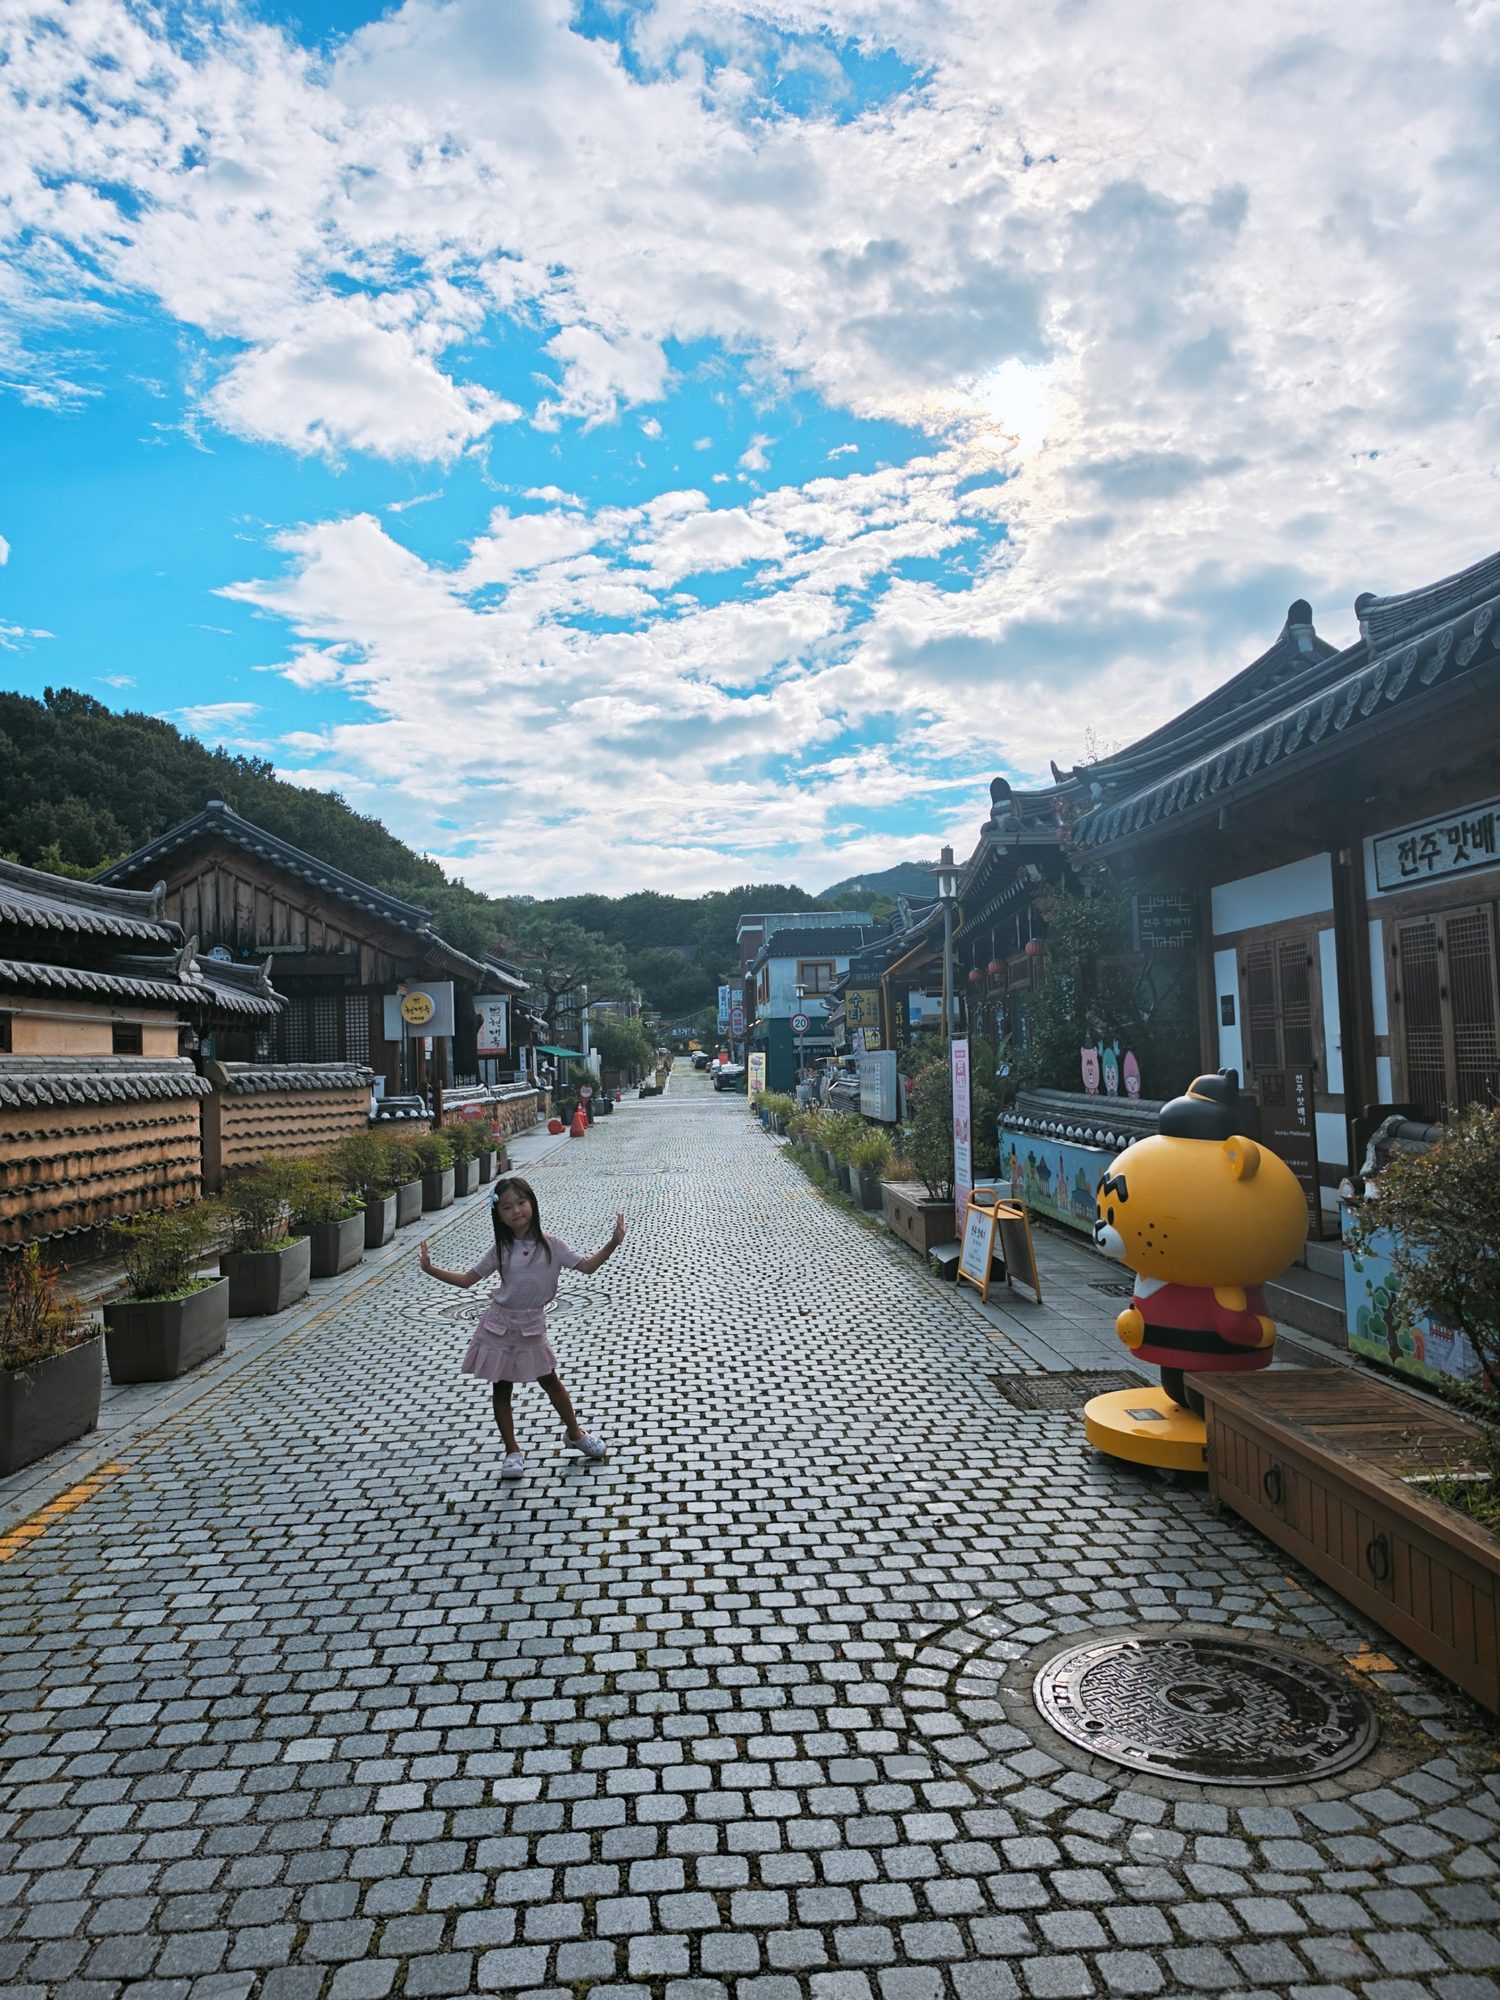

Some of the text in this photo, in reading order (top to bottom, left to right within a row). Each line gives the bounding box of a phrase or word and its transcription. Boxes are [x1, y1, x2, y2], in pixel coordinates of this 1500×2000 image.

[1398, 812, 1500, 877] 전주 맛배
[1143, 918, 1160, 928] 전주
[489, 1017, 501, 1048] 현대옥
[794, 1019, 806, 1028] 20
[1295, 1074, 1304, 1094] 전주
